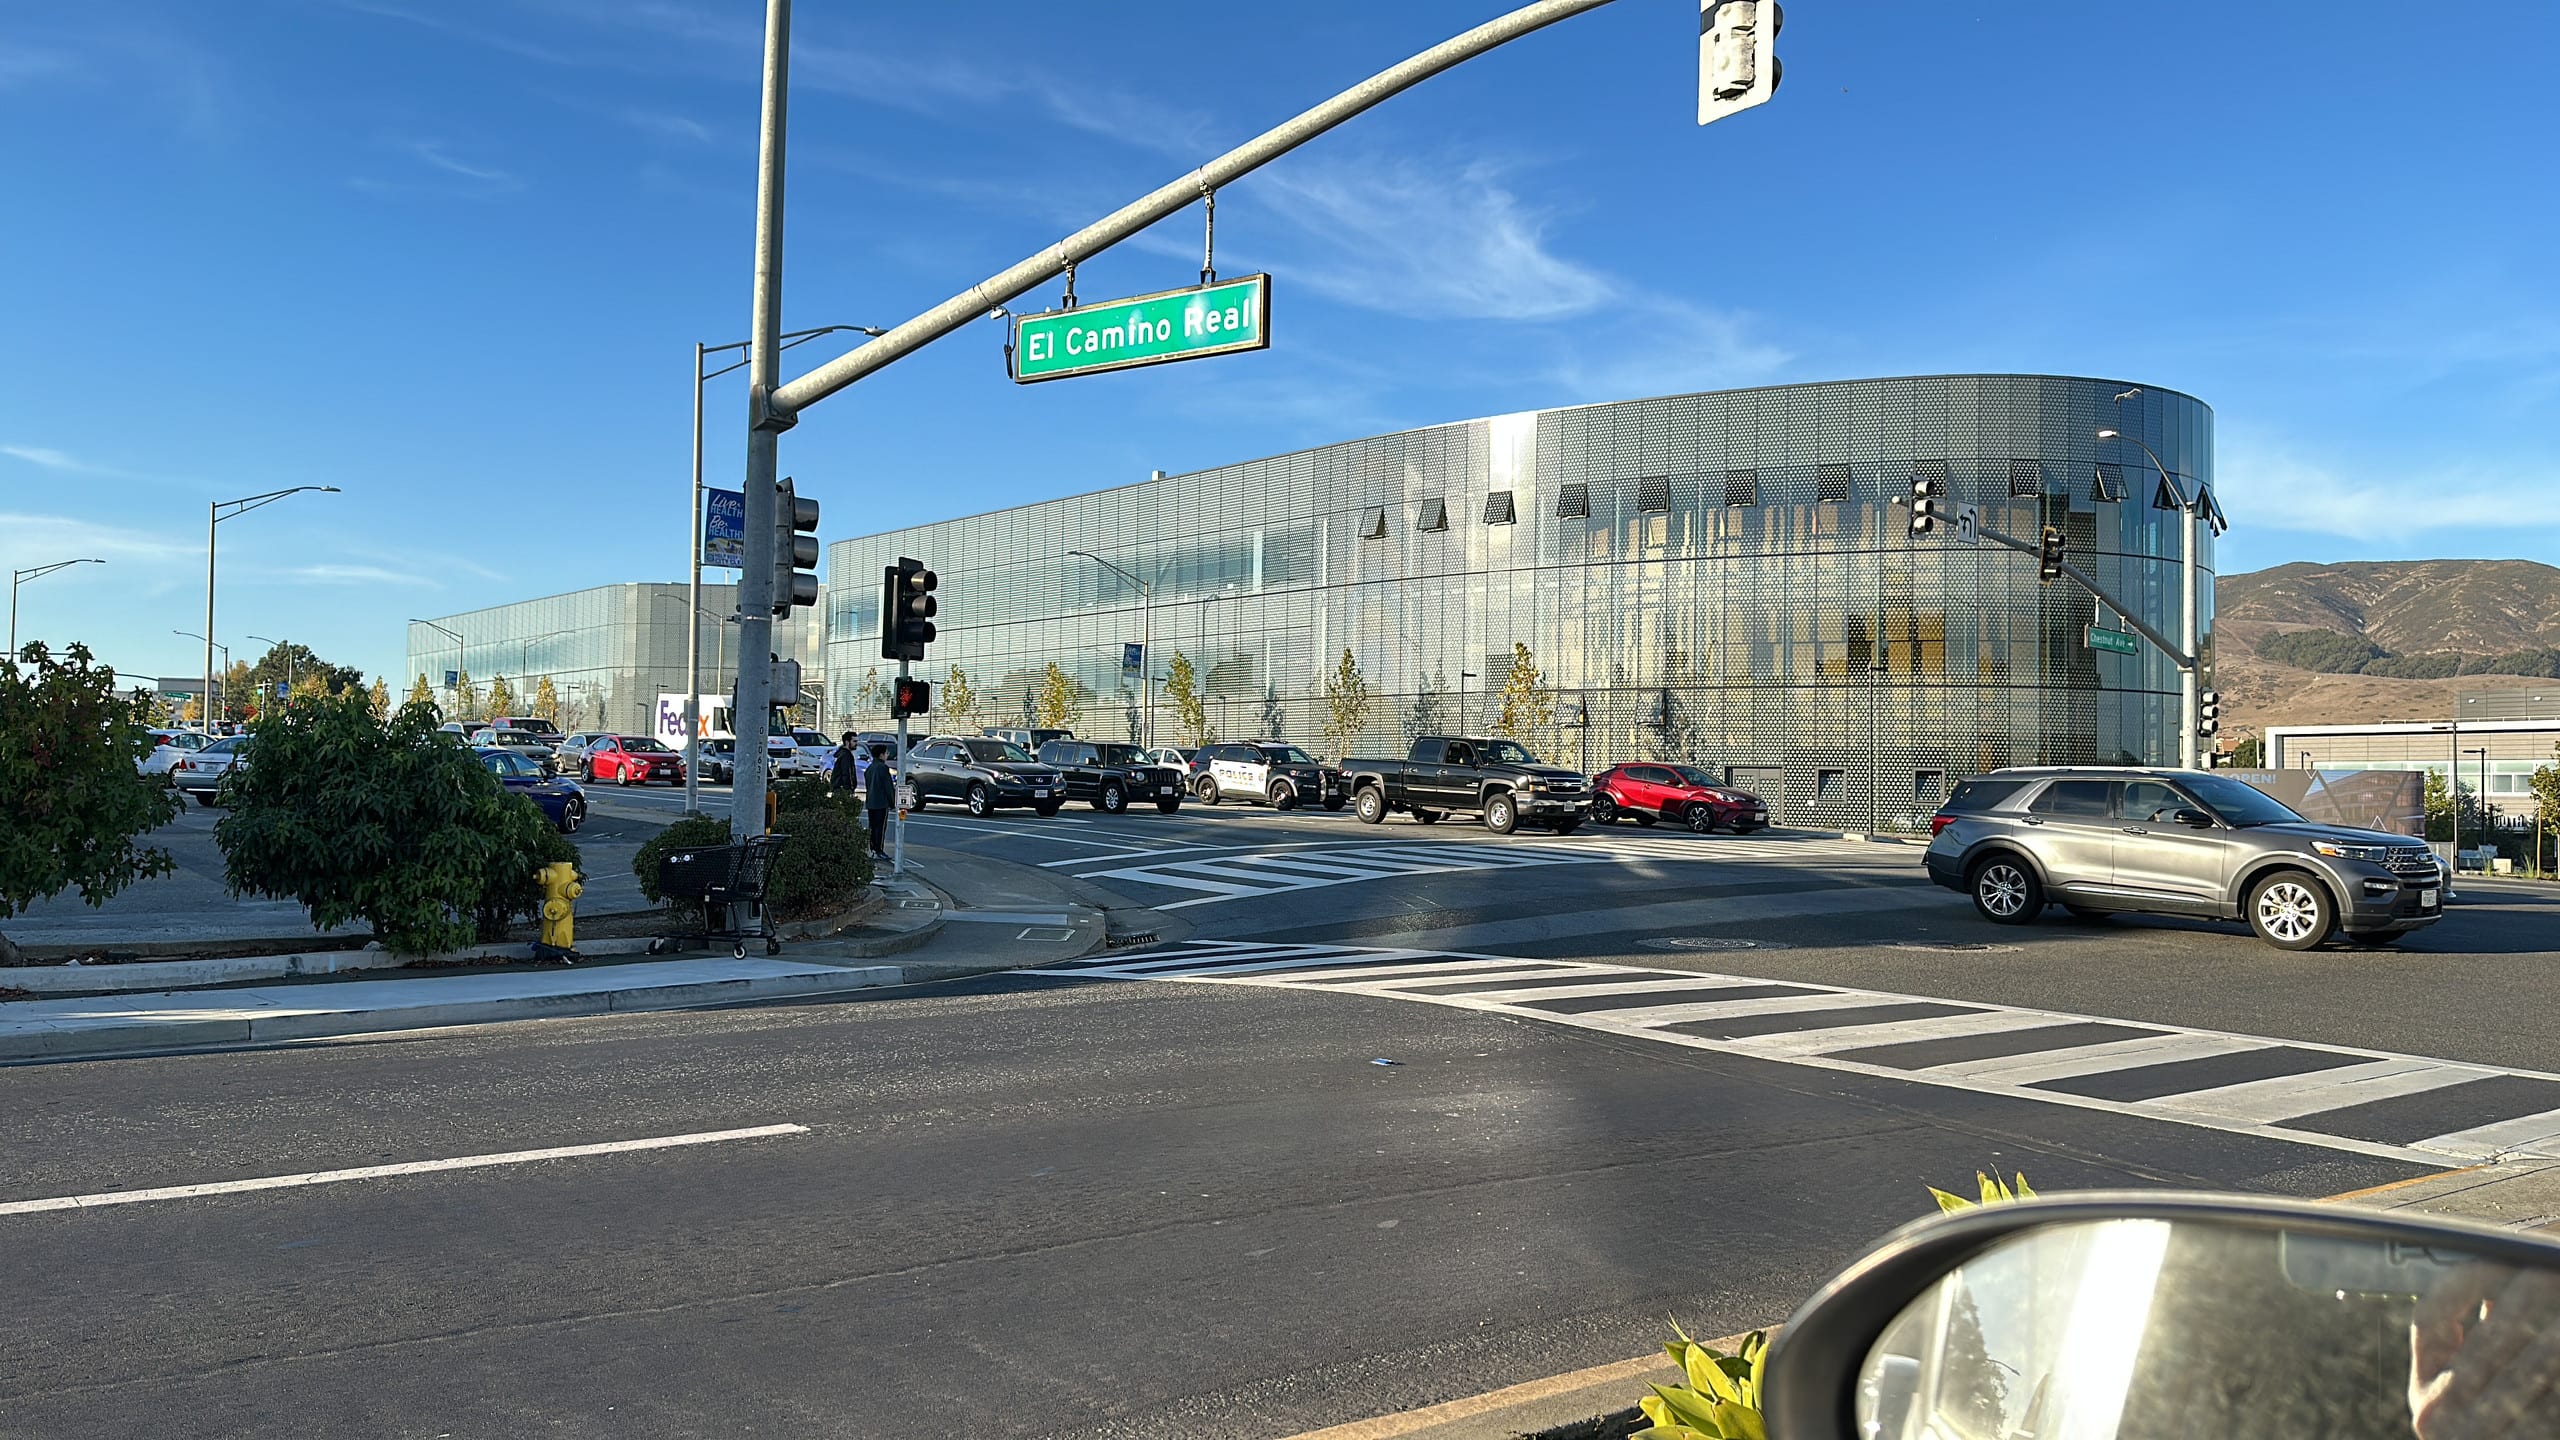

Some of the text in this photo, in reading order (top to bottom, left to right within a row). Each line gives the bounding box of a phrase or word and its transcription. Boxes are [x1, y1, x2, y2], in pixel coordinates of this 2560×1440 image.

[1029, 298, 1249, 361] El Camino Real
[711, 505, 743, 518] HEALTH
[660, 700, 709, 737] Fedx
[1219, 769, 1254, 781] POLICE
